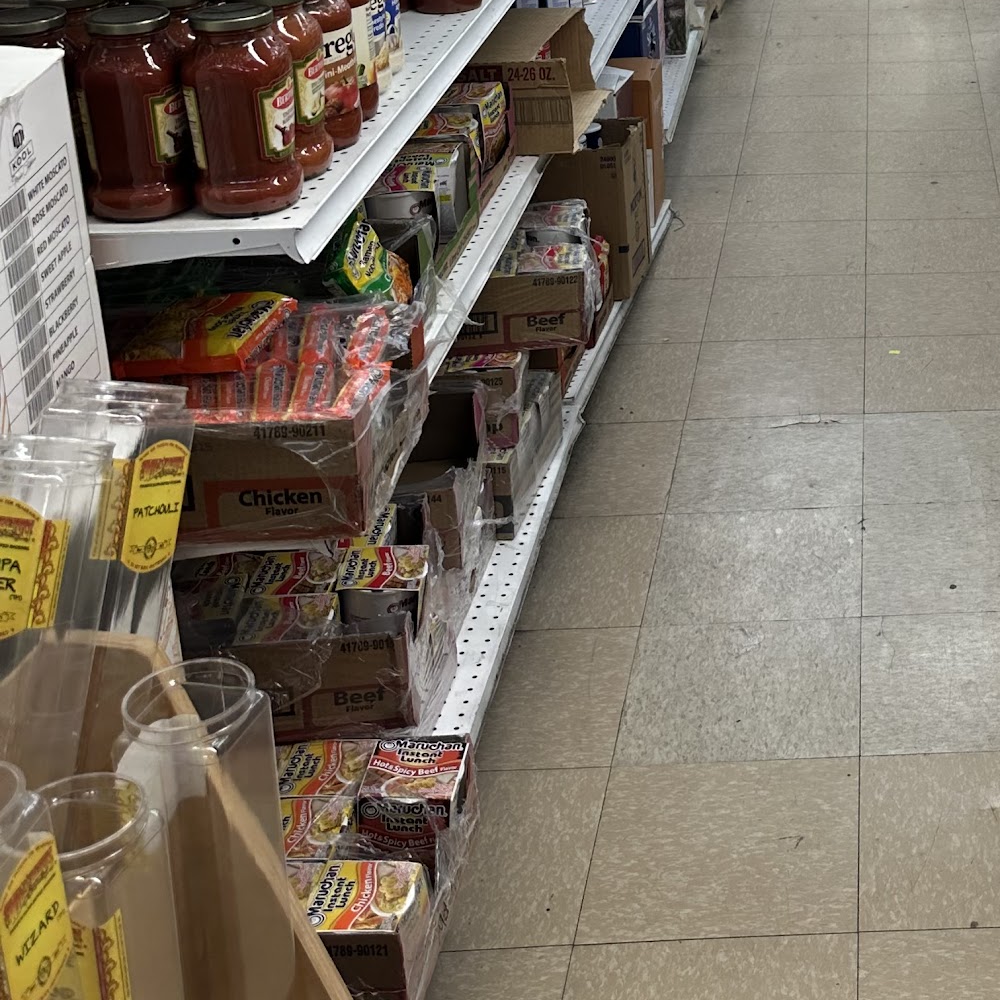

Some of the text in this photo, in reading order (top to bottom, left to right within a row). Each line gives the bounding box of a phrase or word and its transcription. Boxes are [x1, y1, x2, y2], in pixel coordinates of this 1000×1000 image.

[507, 67, 537, 83] 24-26
[539, 66, 556, 82] OZ.
[11, 147, 32, 171] KOOL
[28, 156, 67, 201] WHITE MOSCATO
[32, 183, 69, 228] ROSE MOSCATO
[37, 214, 71, 257] RED MOSCATO
[40, 241, 73, 282] SWEET APPLE
[44, 267, 76, 309] STRAWBERRY
[48, 296, 79, 338] BLACKBERRY
[526, 313, 567, 328] Beef
[535, 325, 557, 333] Flavor
[52, 325, 79, 362] PINEAPPLE
[239, 487, 323, 507] Chicken
[132, 501, 180, 519] PATCHOULI
[265, 506, 299, 516] Flavor
[333, 689, 385, 706] Beef
[396, 740, 464, 751] Maruchan
[396, 749, 443, 758] Instant
[400, 755, 436, 765] Lunch
[417, 764, 438, 775] Beef
[381, 815, 429, 826] Instant
[386, 822, 423, 833] Lunch
[408, 836, 429, 848] Beef
[307, 864, 342, 917] Maruchan
[323, 876, 347, 912] Instant
[336, 880, 356, 909] Lunch
[350, 879, 374, 913] Chicken
[15, 899, 60, 967] WIZARD
